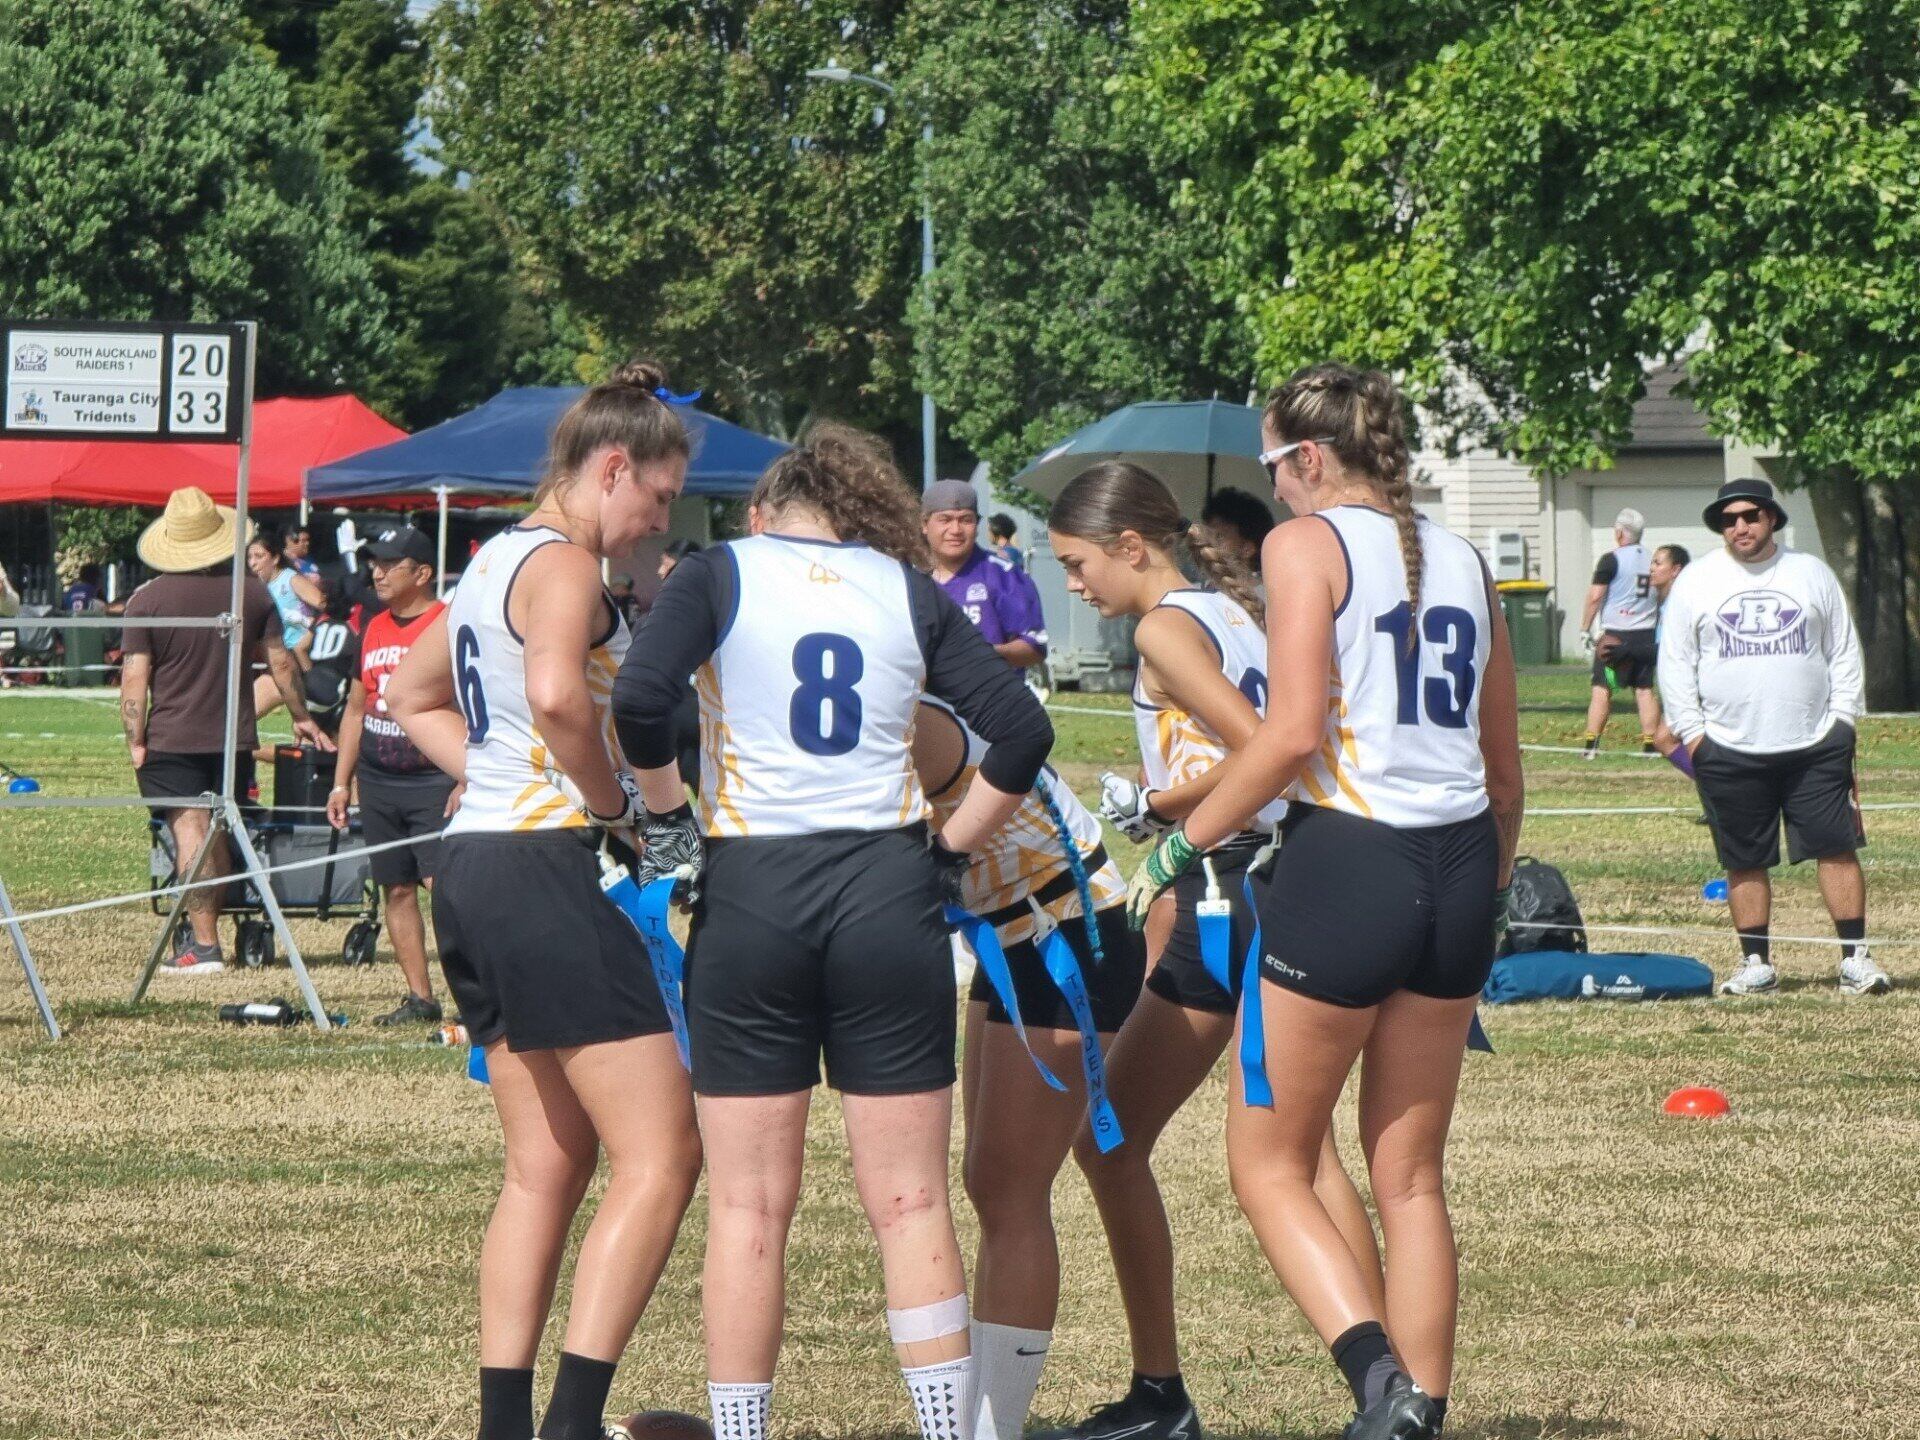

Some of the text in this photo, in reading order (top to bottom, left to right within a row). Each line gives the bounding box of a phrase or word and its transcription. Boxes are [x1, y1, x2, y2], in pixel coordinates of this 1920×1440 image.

[54, 346, 92, 358] SOUTH
[95, 347, 157, 359] AUCKLAND
[75, 360, 133, 371] RAIDERS 1
[52, 390, 159, 408] Tauranga City
[74, 409, 136, 423] Tridents
[1737, 597, 1782, 635] R
[309, 622, 348, 660] 10
[1715, 616, 1808, 659] RAIDERNATION
[1375, 600, 1477, 729] 13
[455, 624, 490, 744] 6
[789, 632, 864, 756] 8
[1264, 953, 1308, 981] ECHT
